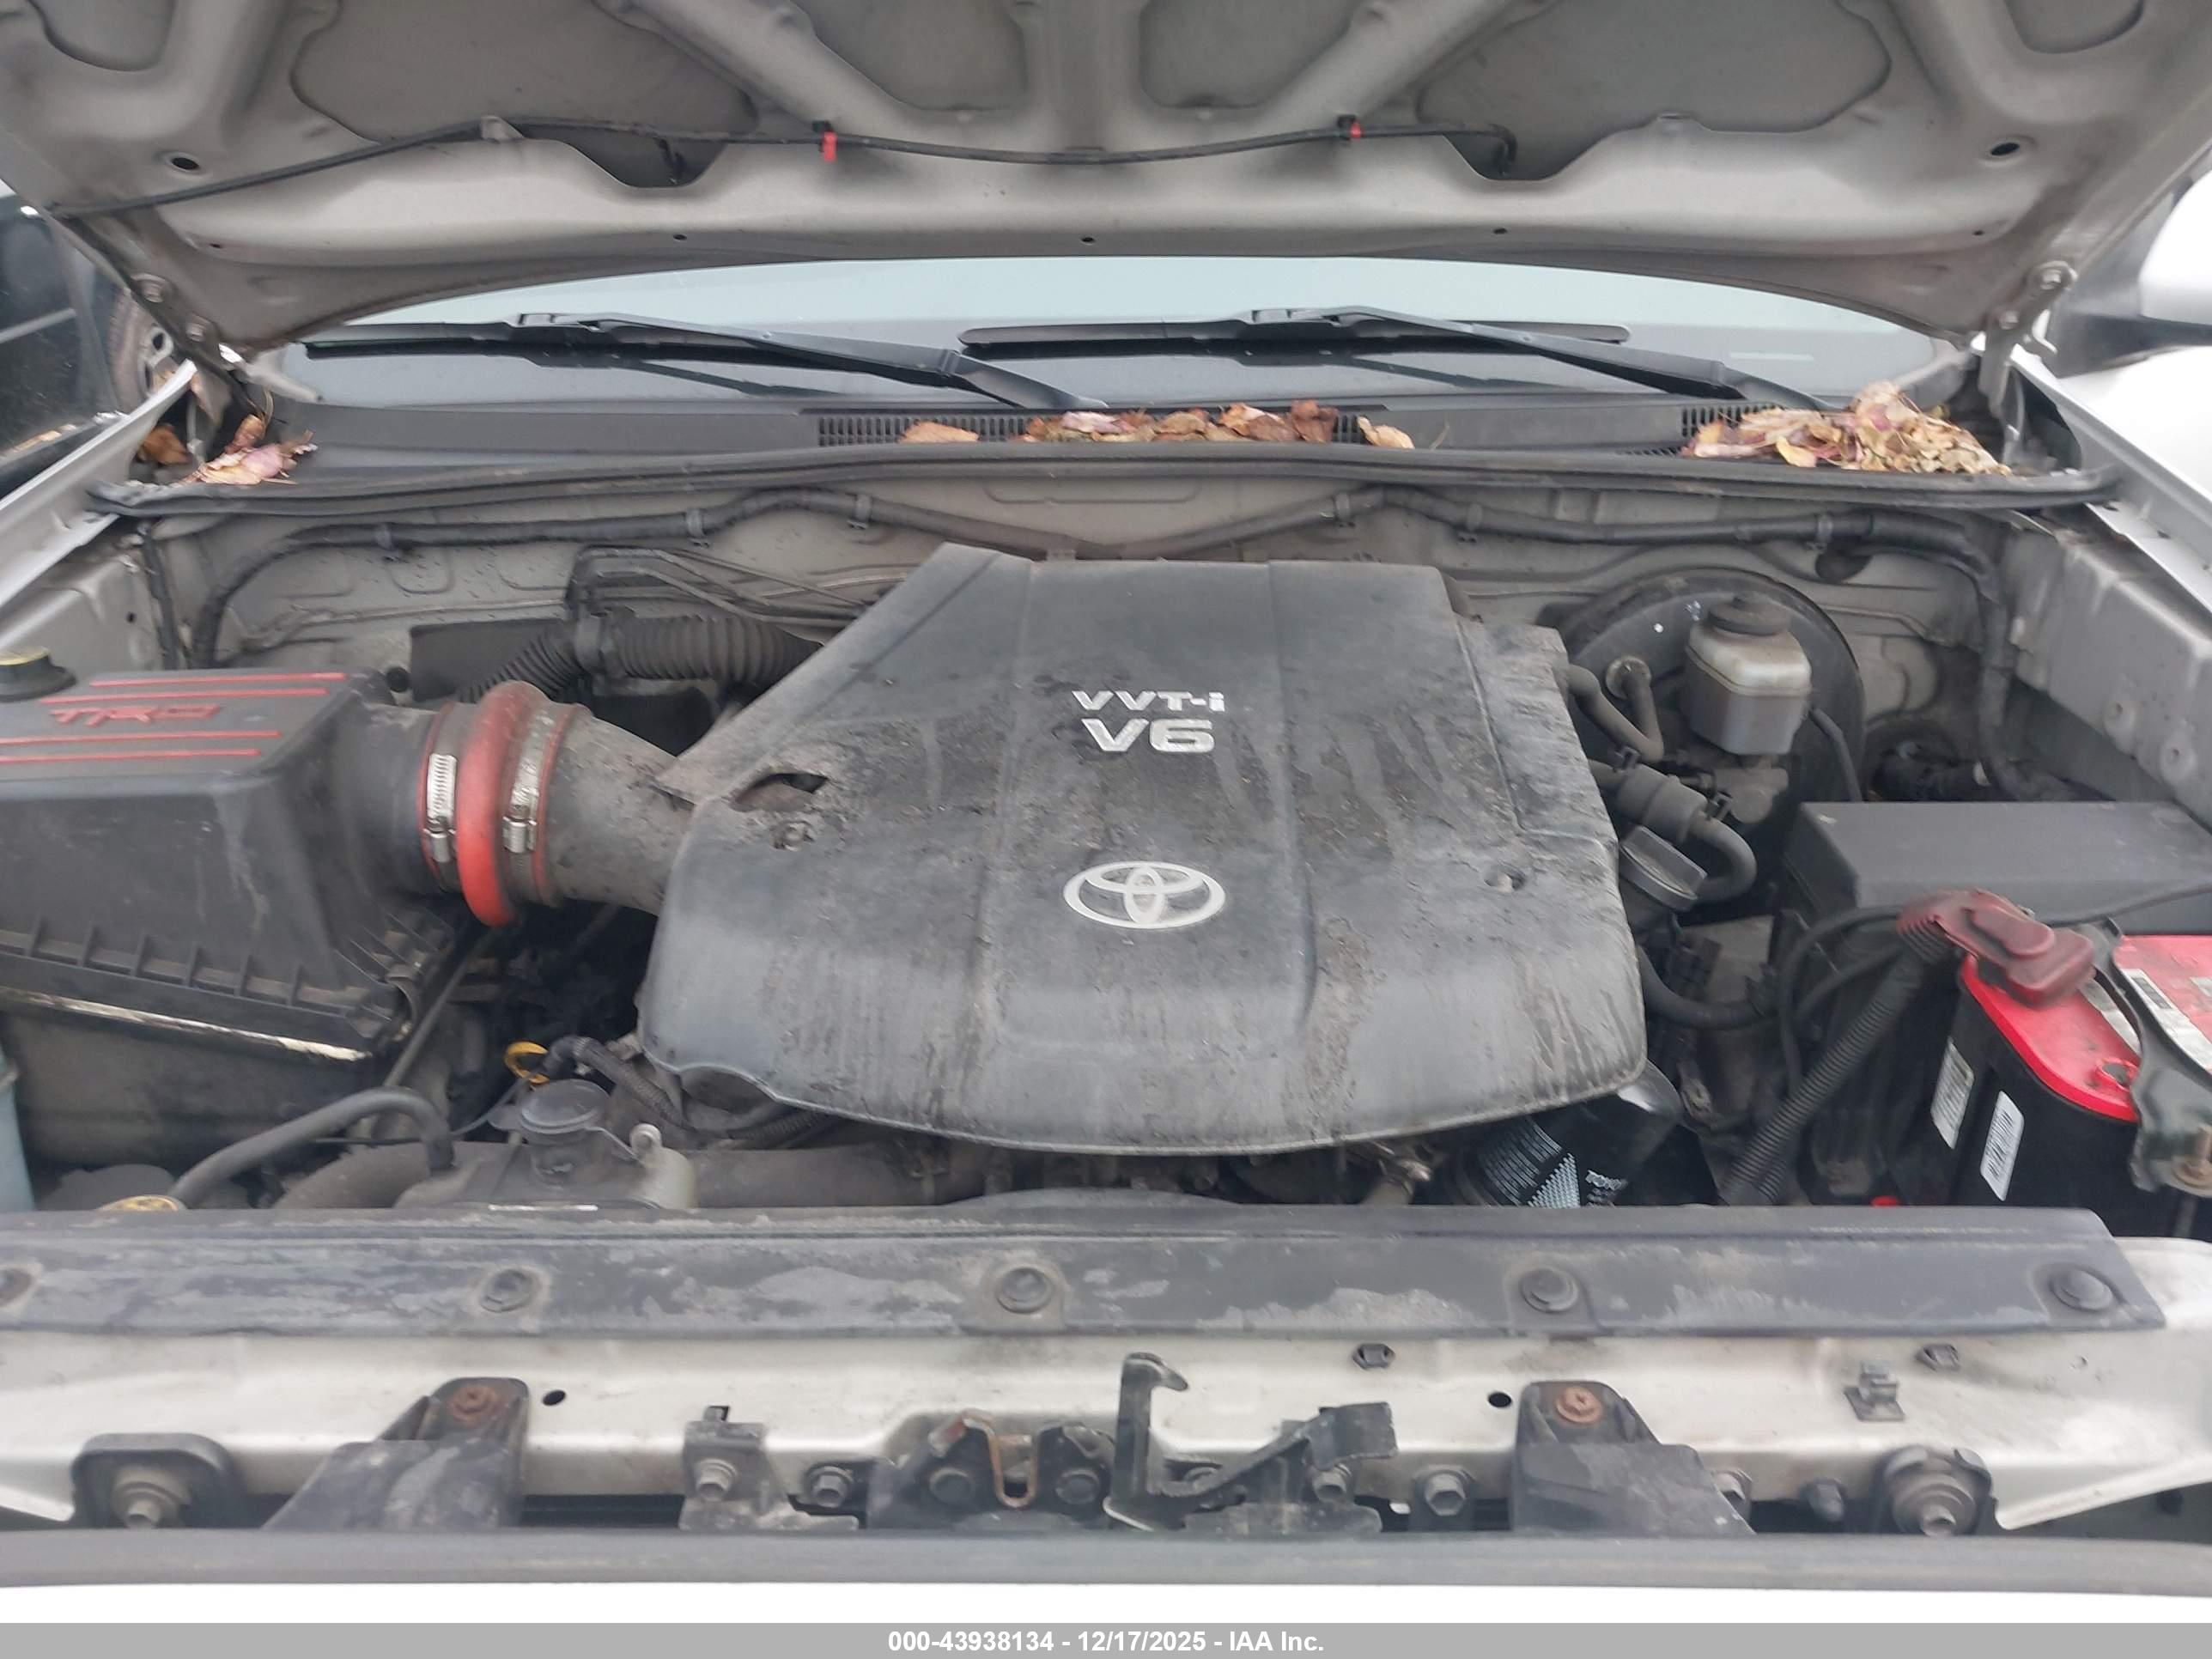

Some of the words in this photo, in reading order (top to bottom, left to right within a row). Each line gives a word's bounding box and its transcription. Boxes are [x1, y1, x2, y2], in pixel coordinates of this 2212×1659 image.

[1072, 690, 1225, 712] VVT-i
[50, 705, 220, 726] TRD
[1081, 718, 1215, 753] V6
